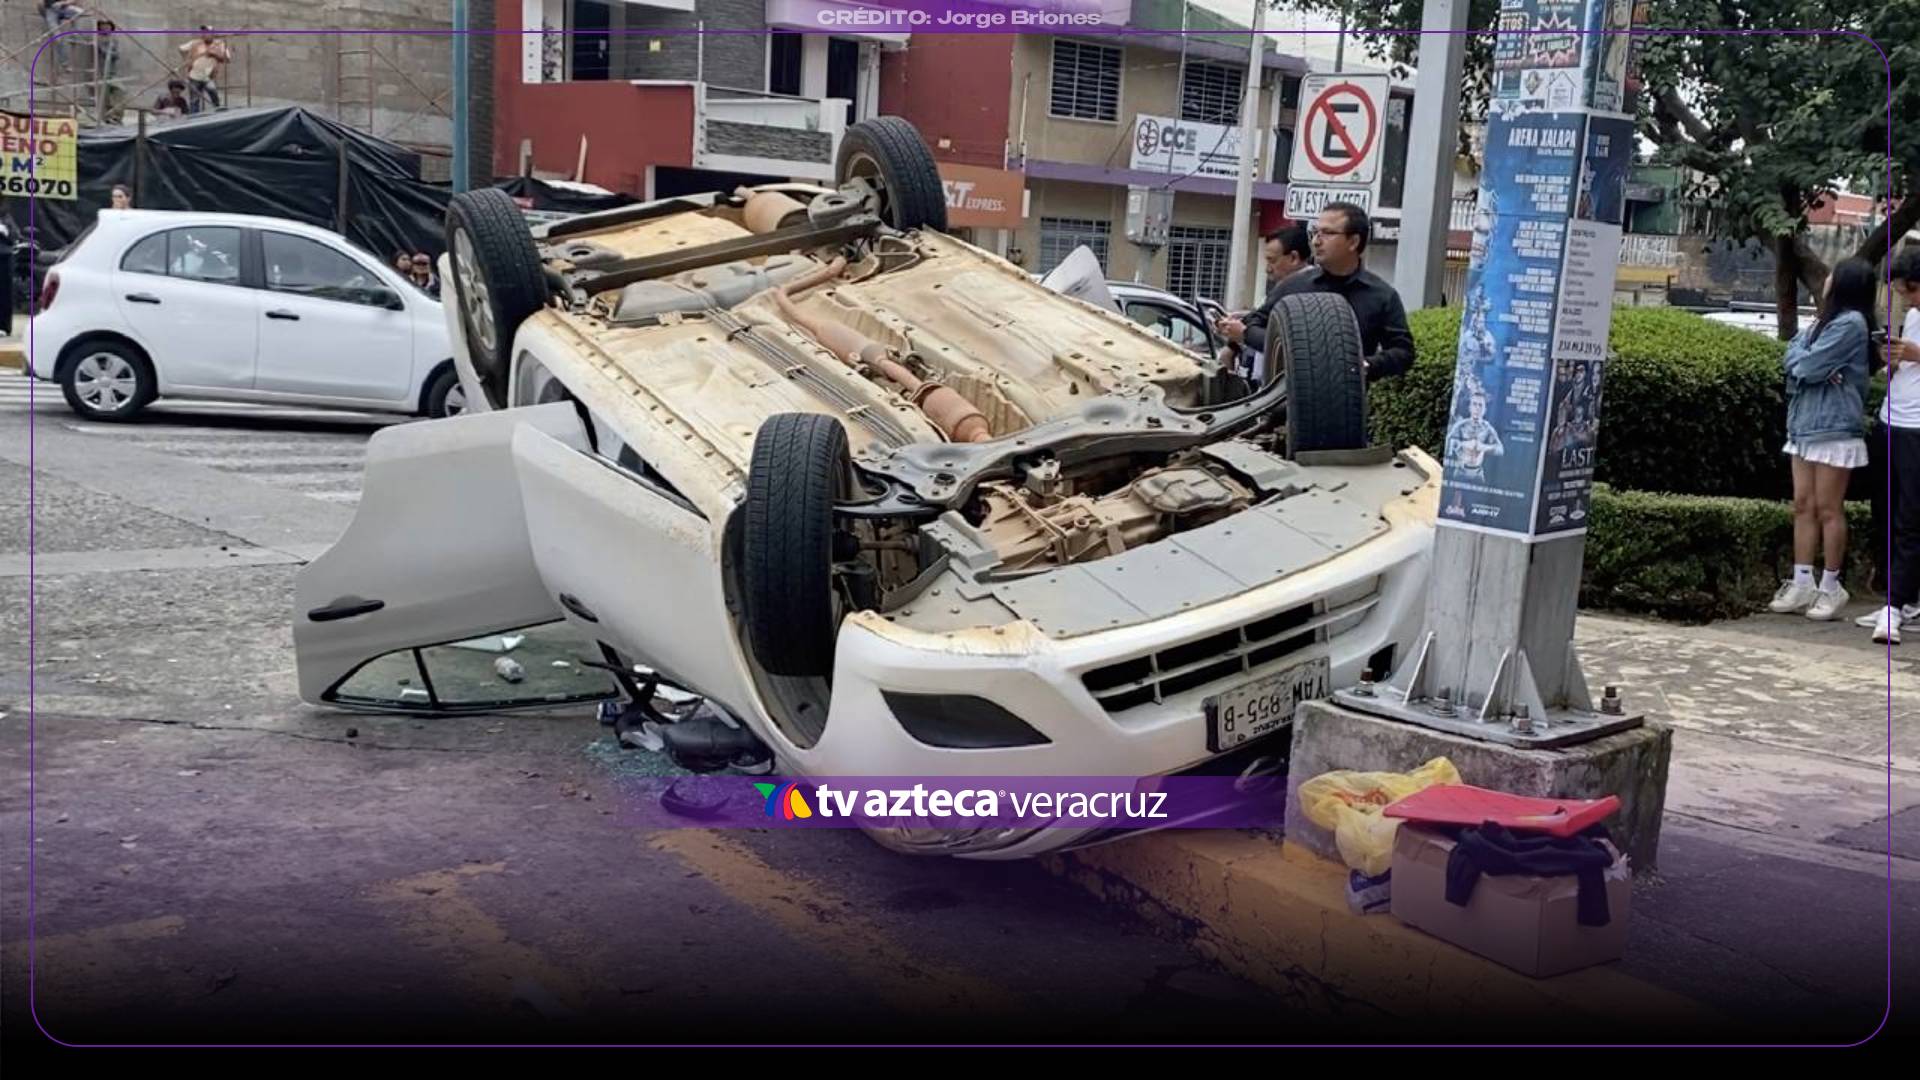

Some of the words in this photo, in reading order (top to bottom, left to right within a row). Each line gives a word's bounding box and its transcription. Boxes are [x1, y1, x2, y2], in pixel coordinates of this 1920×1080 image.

[1161, 126, 1197, 151] CCE
[1508, 127, 1538, 148] ARENA
[1540, 129, 1576, 149] XALAPA
[1289, 189, 1304, 213] EN
[1562, 447, 1594, 468] LAST
